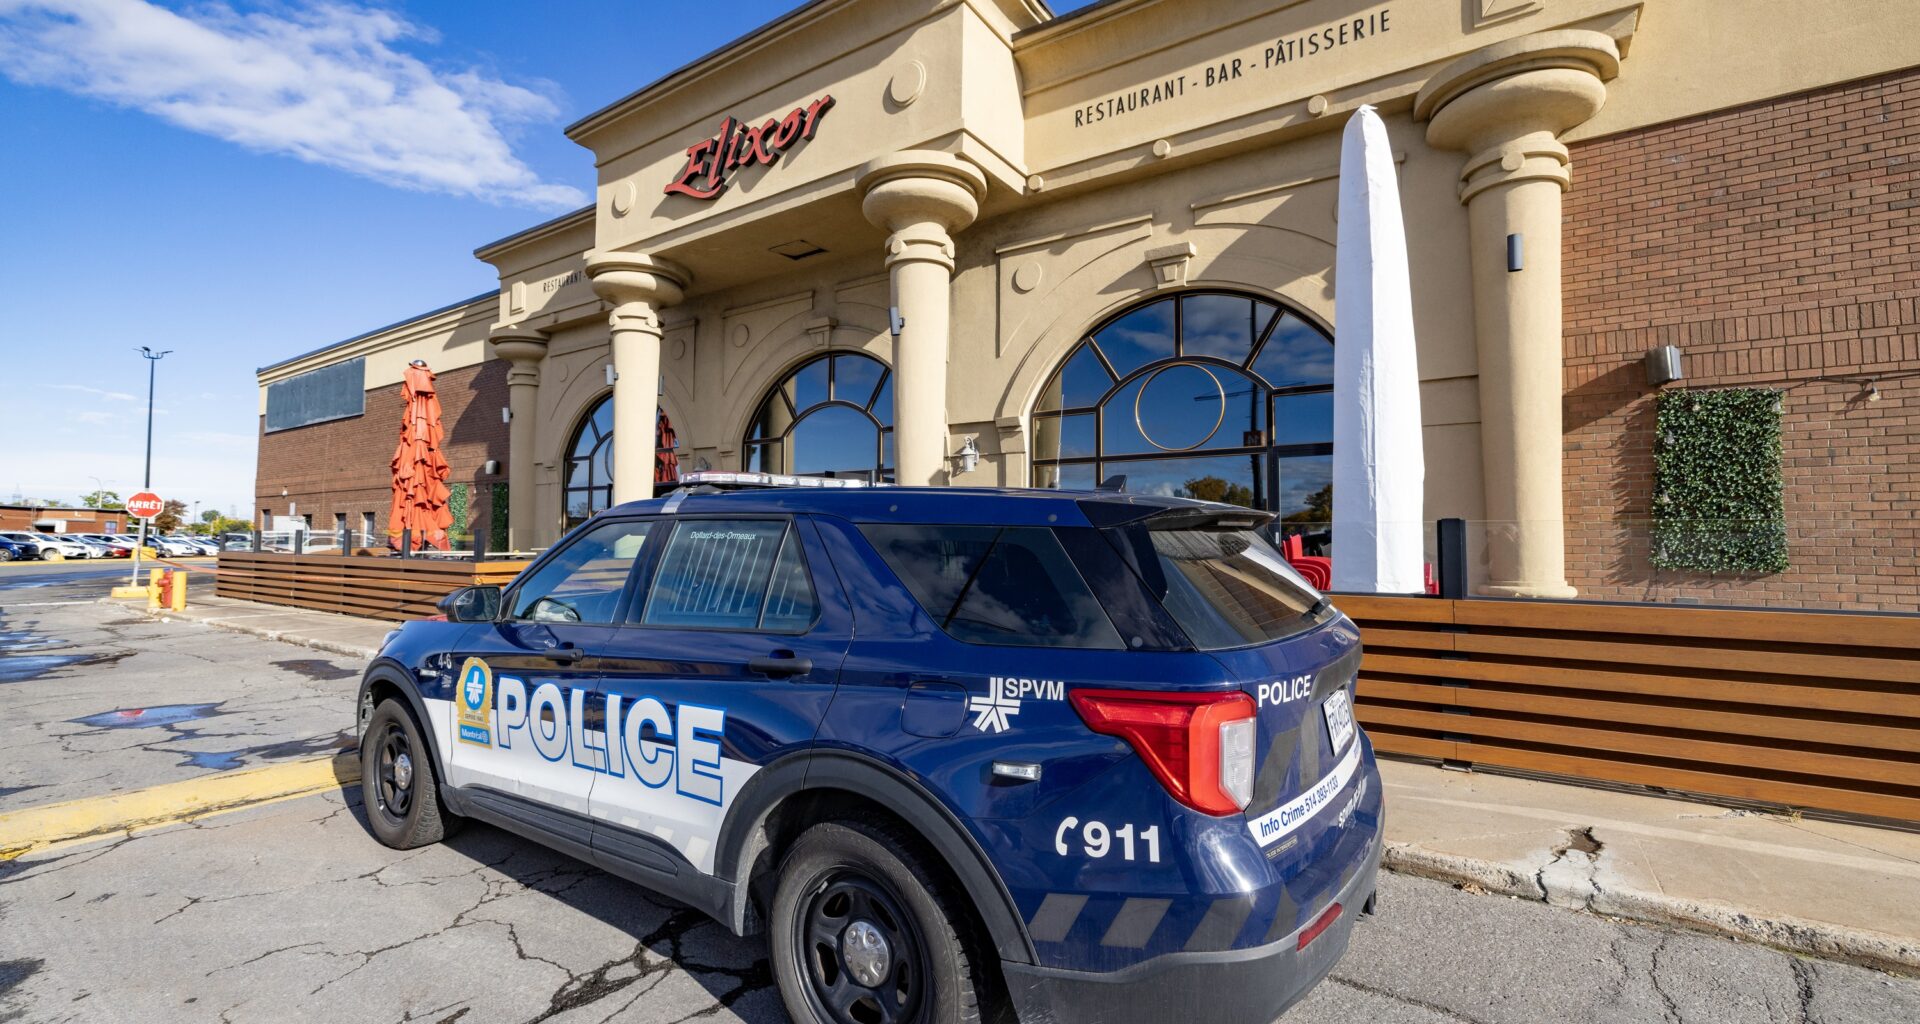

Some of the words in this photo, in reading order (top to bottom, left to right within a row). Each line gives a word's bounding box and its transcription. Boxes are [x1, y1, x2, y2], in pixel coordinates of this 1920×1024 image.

[1074, 75, 1186, 128] RESTAURANT
[1205, 57, 1242, 87] BAR
[1265, 9, 1390, 69] PÂTISSERIE
[664, 94, 836, 199] Elixor
[543, 270, 582, 293] RESTAURANT
[128, 500, 162, 510] ARRÊT
[690, 531, 757, 541] Dollard-des-Ormeaux
[1005, 677, 1064, 701] SPVM
[1258, 674, 1311, 707] POLICE
[496, 674, 727, 807] POLICE
[1260, 817, 1280, 838] Info
[1281, 807, 1305, 827] Crime
[1305, 793, 1317, 812] 514
[1083, 820, 1160, 863] 911
